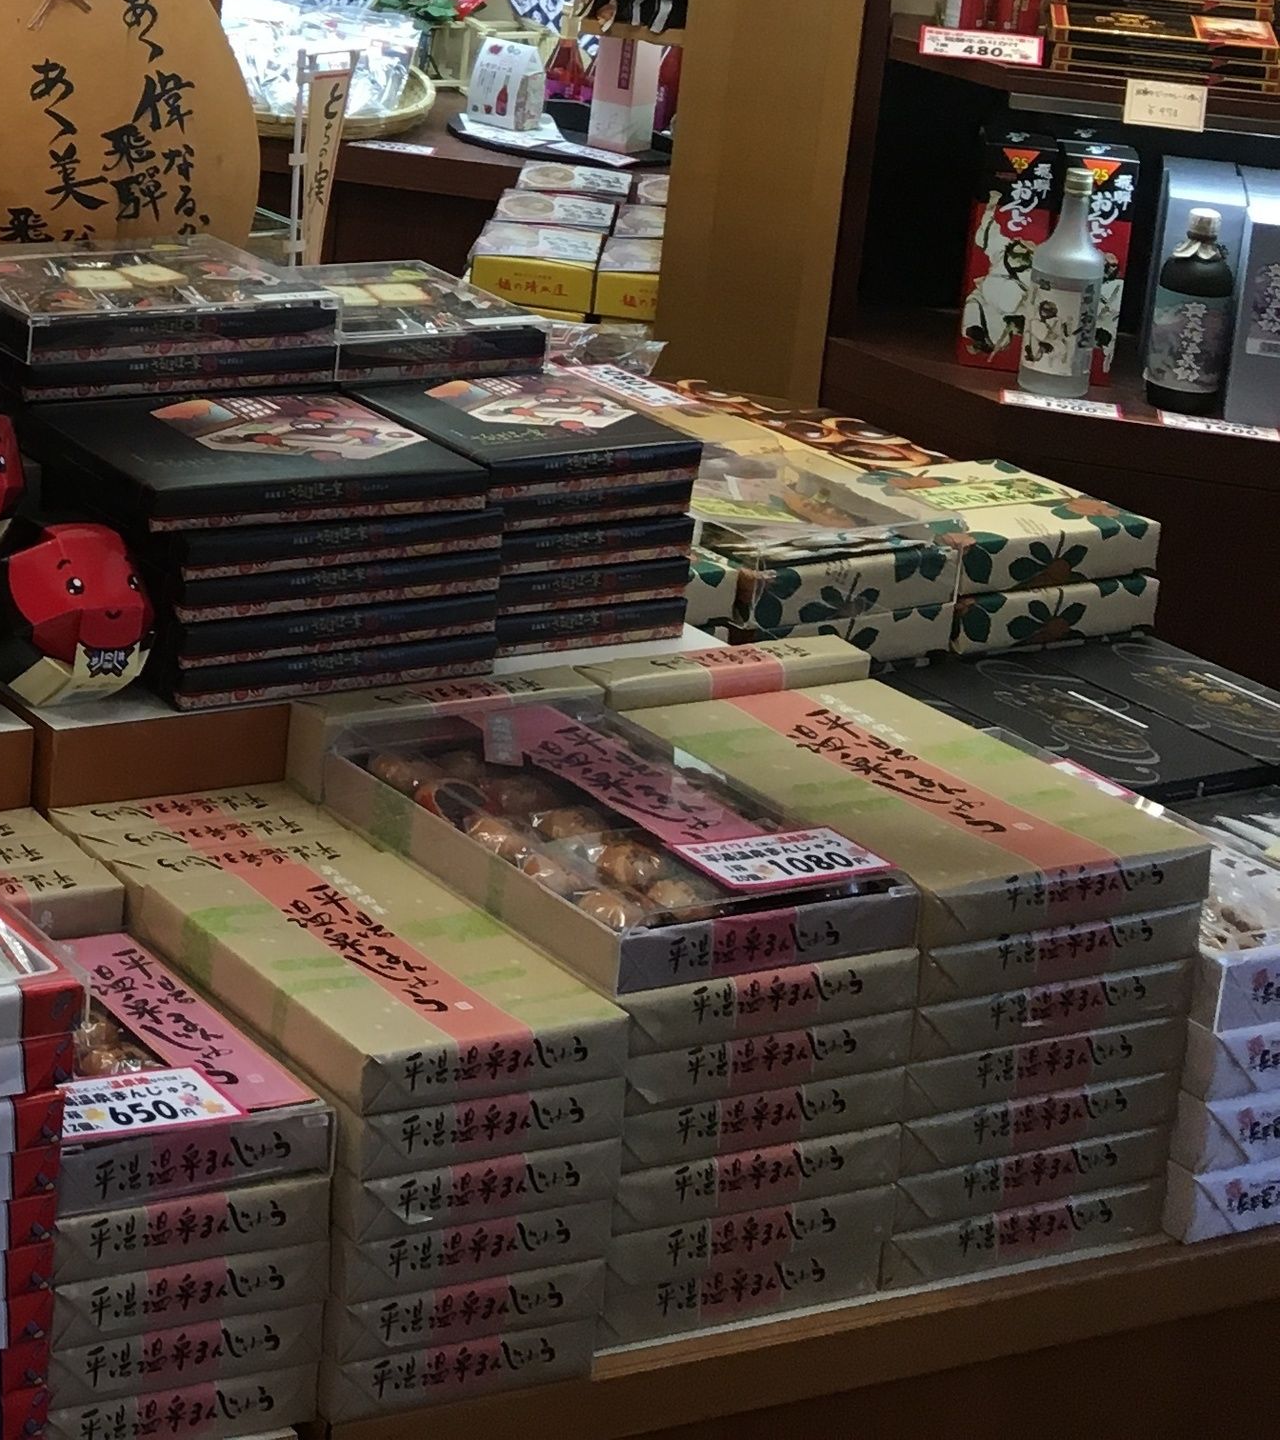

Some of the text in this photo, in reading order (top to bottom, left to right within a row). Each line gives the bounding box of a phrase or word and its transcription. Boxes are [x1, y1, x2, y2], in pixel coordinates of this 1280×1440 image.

[962, 44, 1014, 59] 480円
[1011, 155, 1030, 170] 25
[1092, 168, 1110, 181] 25
[998, 179, 1039, 232] おんど
[765, 849, 869, 879] 1080円
[107, 1098, 198, 1127] 650円
